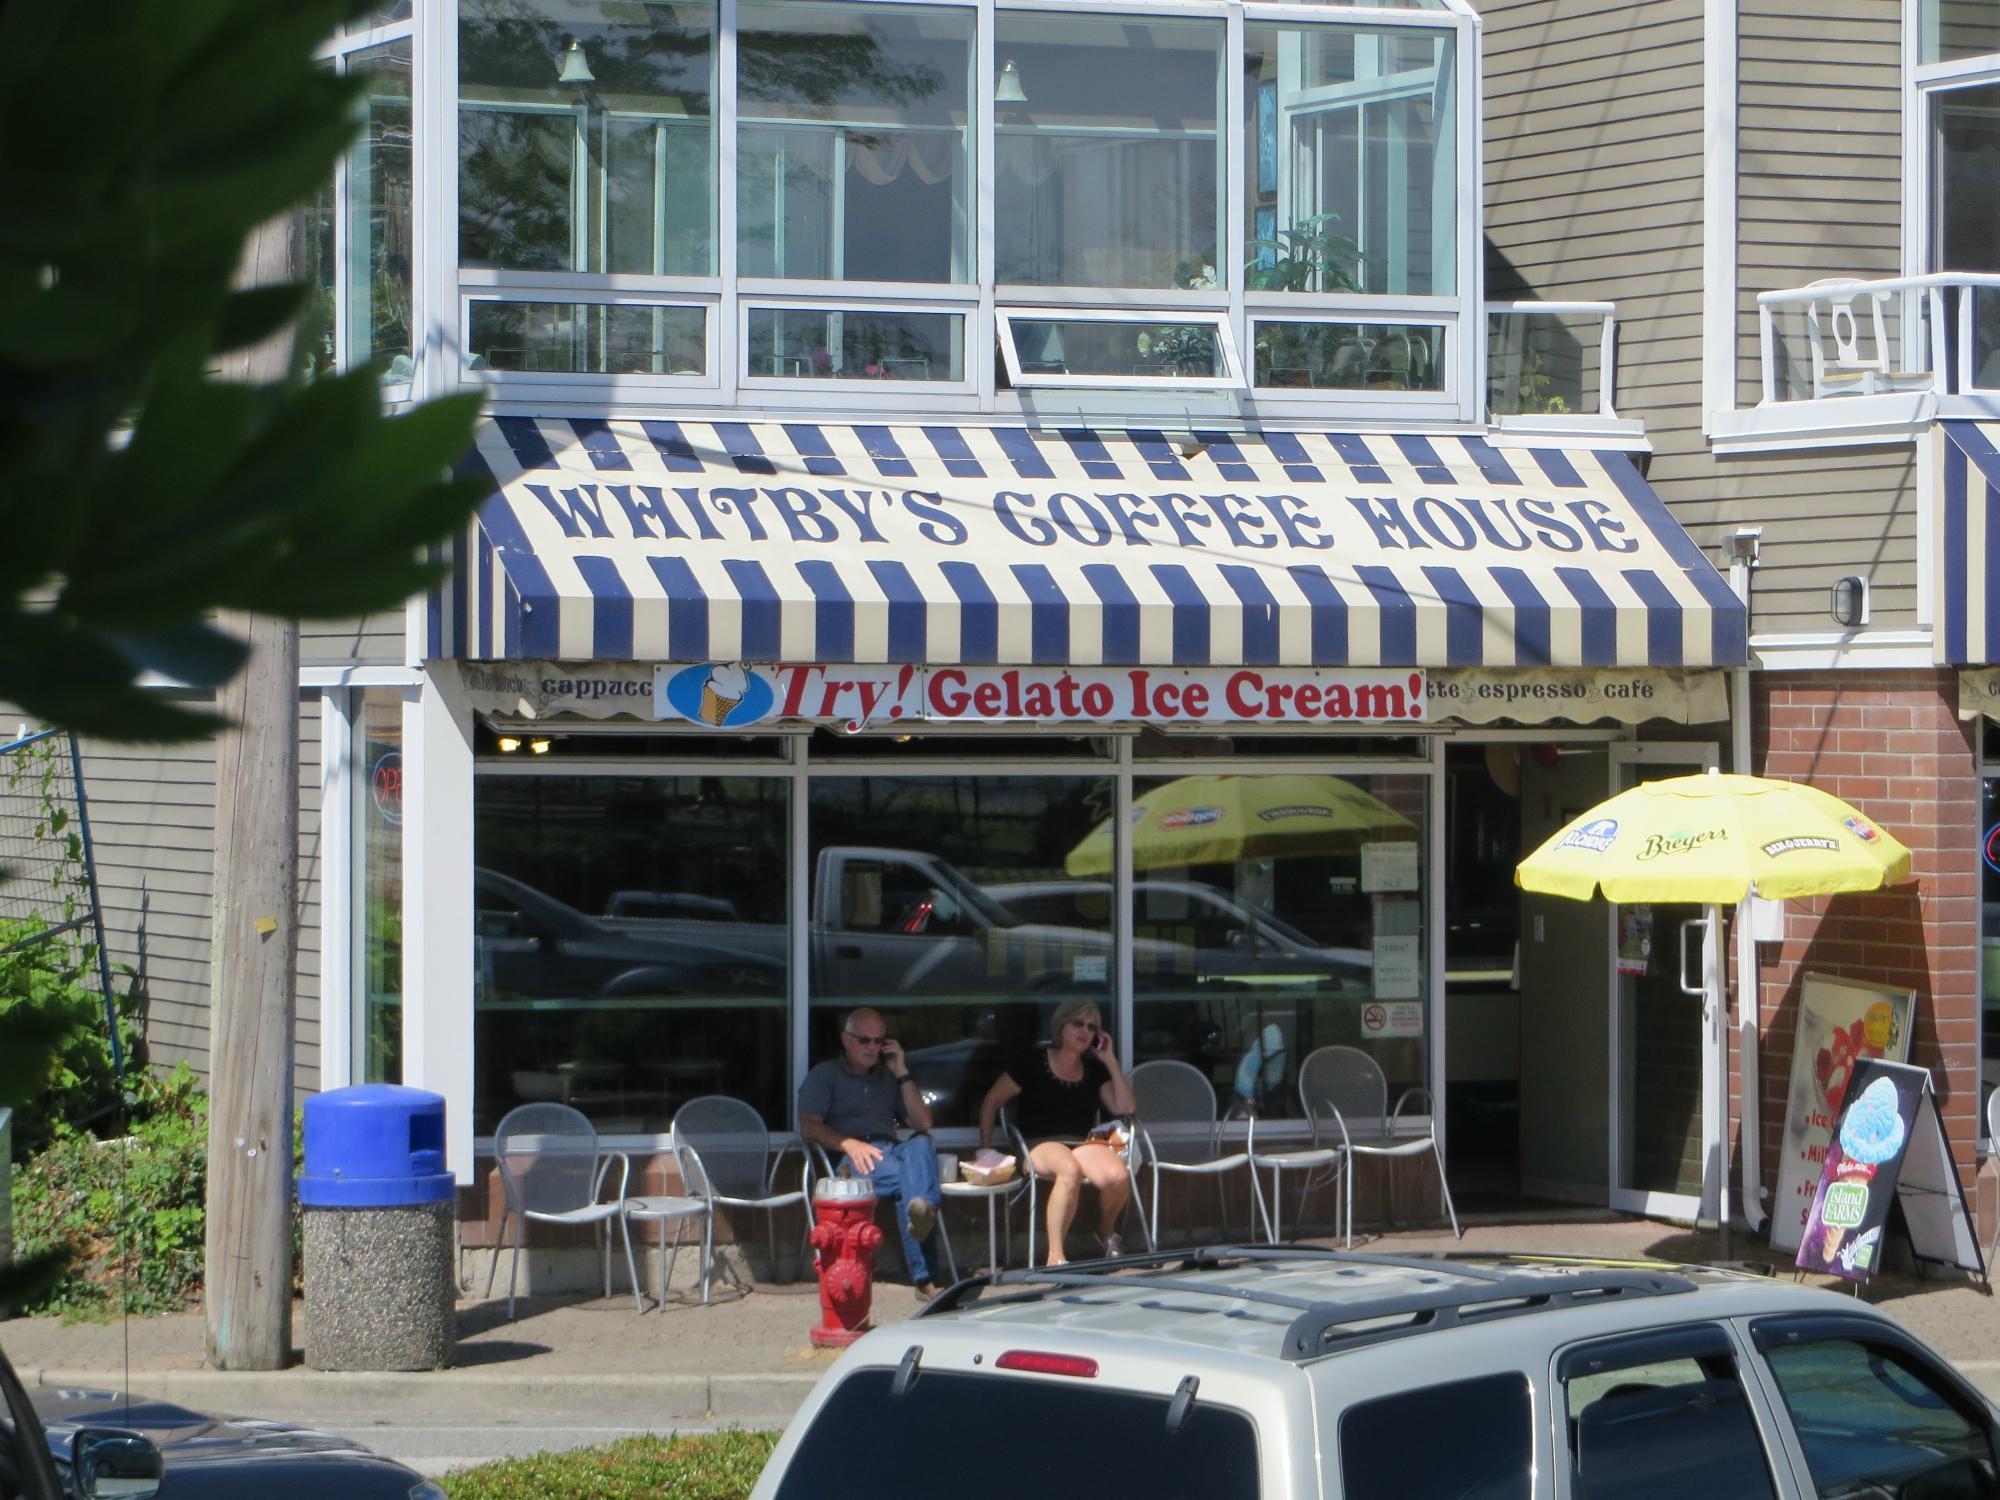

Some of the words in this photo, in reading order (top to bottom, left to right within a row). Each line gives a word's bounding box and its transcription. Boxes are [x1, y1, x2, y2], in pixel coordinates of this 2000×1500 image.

[524, 484, 967, 545] WHITBY'S
[993, 492, 1334, 548] COFFEE
[1346, 497, 1638, 552] HOUSE
[541, 679, 653, 700] cappucc
[776, 664, 914, 733] Try!
[928, 669, 1115, 717] Gelato
[1129, 671, 1210, 717] Ice
[1226, 671, 1423, 719] Cream!
[1478, 682, 1587, 702] espresso
[1603, 679, 1655, 699] café
[1636, 828, 1726, 861] Breyers
[1811, 1109, 1827, 1129] Ice
[1825, 1202, 1861, 1222] FARMS
